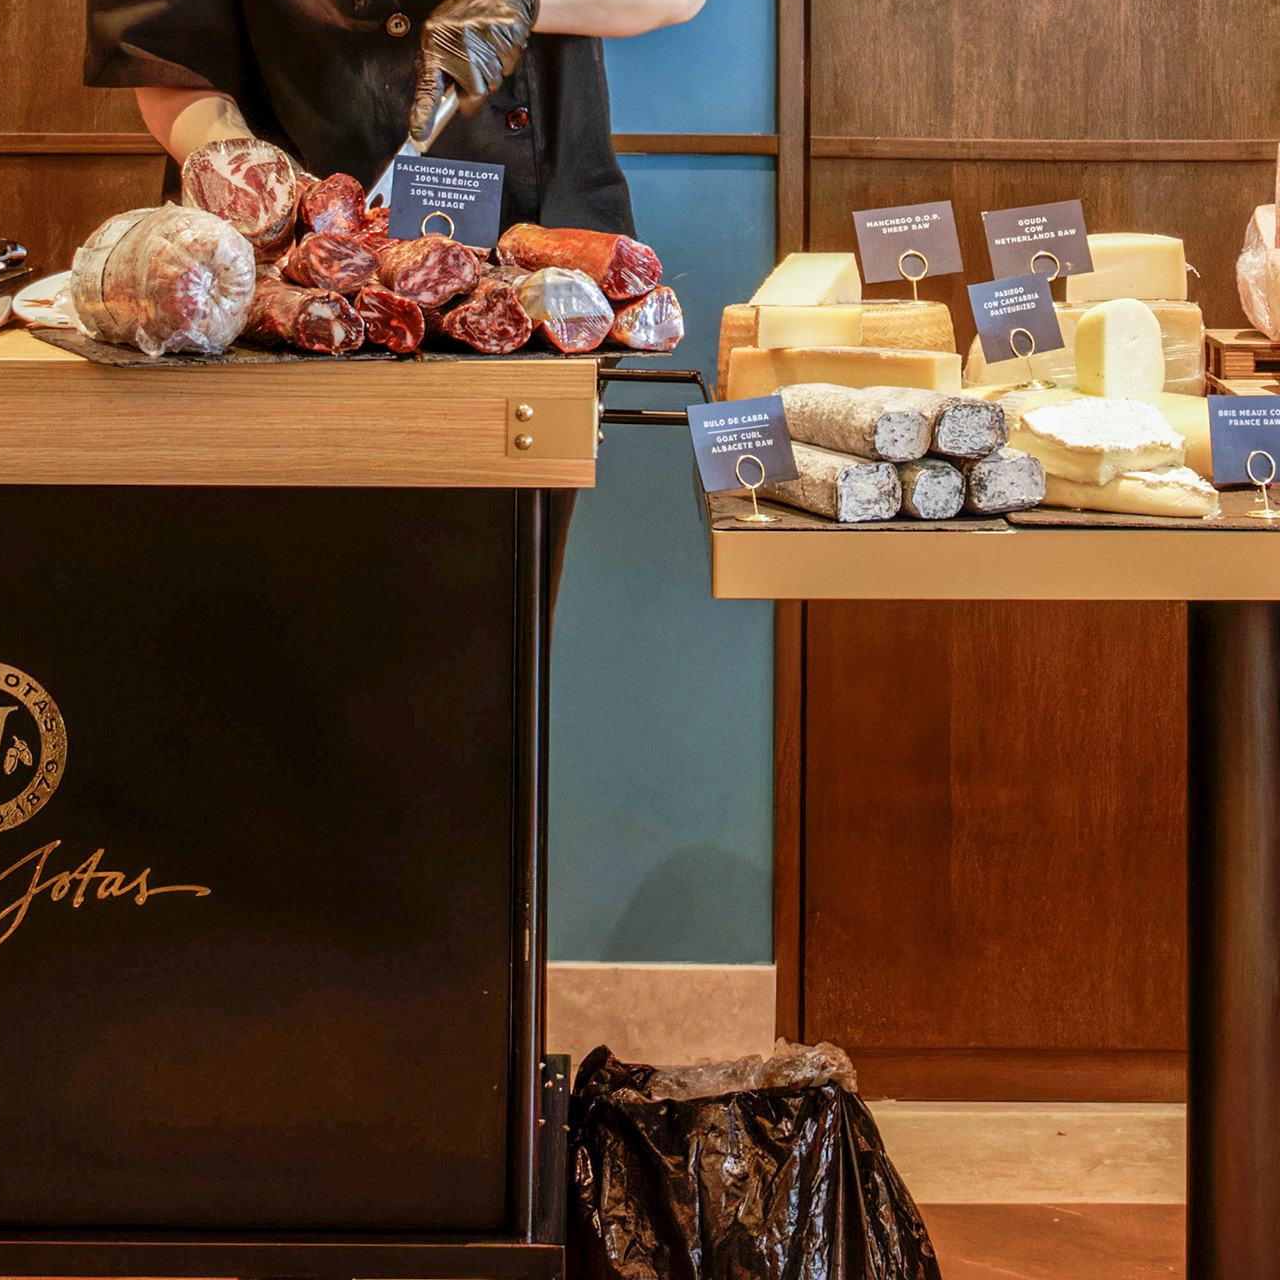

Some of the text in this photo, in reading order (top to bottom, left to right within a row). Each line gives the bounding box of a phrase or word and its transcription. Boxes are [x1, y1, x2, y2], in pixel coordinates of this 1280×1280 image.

[396, 163, 499, 181] SALCHICHÓN BELLOTA
[415, 174, 480, 188] 100% IBÉRICO
[410, 188, 475, 201] 100% IBERIAN
[422, 198, 465, 210] SAUSAGE
[866, 213, 941, 228] MANCHEGO D.O.P.
[1018, 216, 1048, 227] GOUDA
[882, 222, 930, 234] SHEEP RAW
[1024, 225, 1044, 234] COW
[994, 228, 1077, 246] NETHERLANDS RAW
[994, 286, 1024, 298] PASIEGO
[983, 292, 1040, 309] COW CANTABRIA
[990, 302, 1036, 317] PASTEURIZED
[1218, 409, 1237, 417] BRIE
[703, 413, 769, 428] RULO DE CABRA
[1228, 418, 1261, 426] FRANCE
[716, 431, 762, 443] GOAT CURL
[711, 439, 774, 454] ALBACETE RAW
[15, 760, 59, 816] 1879
